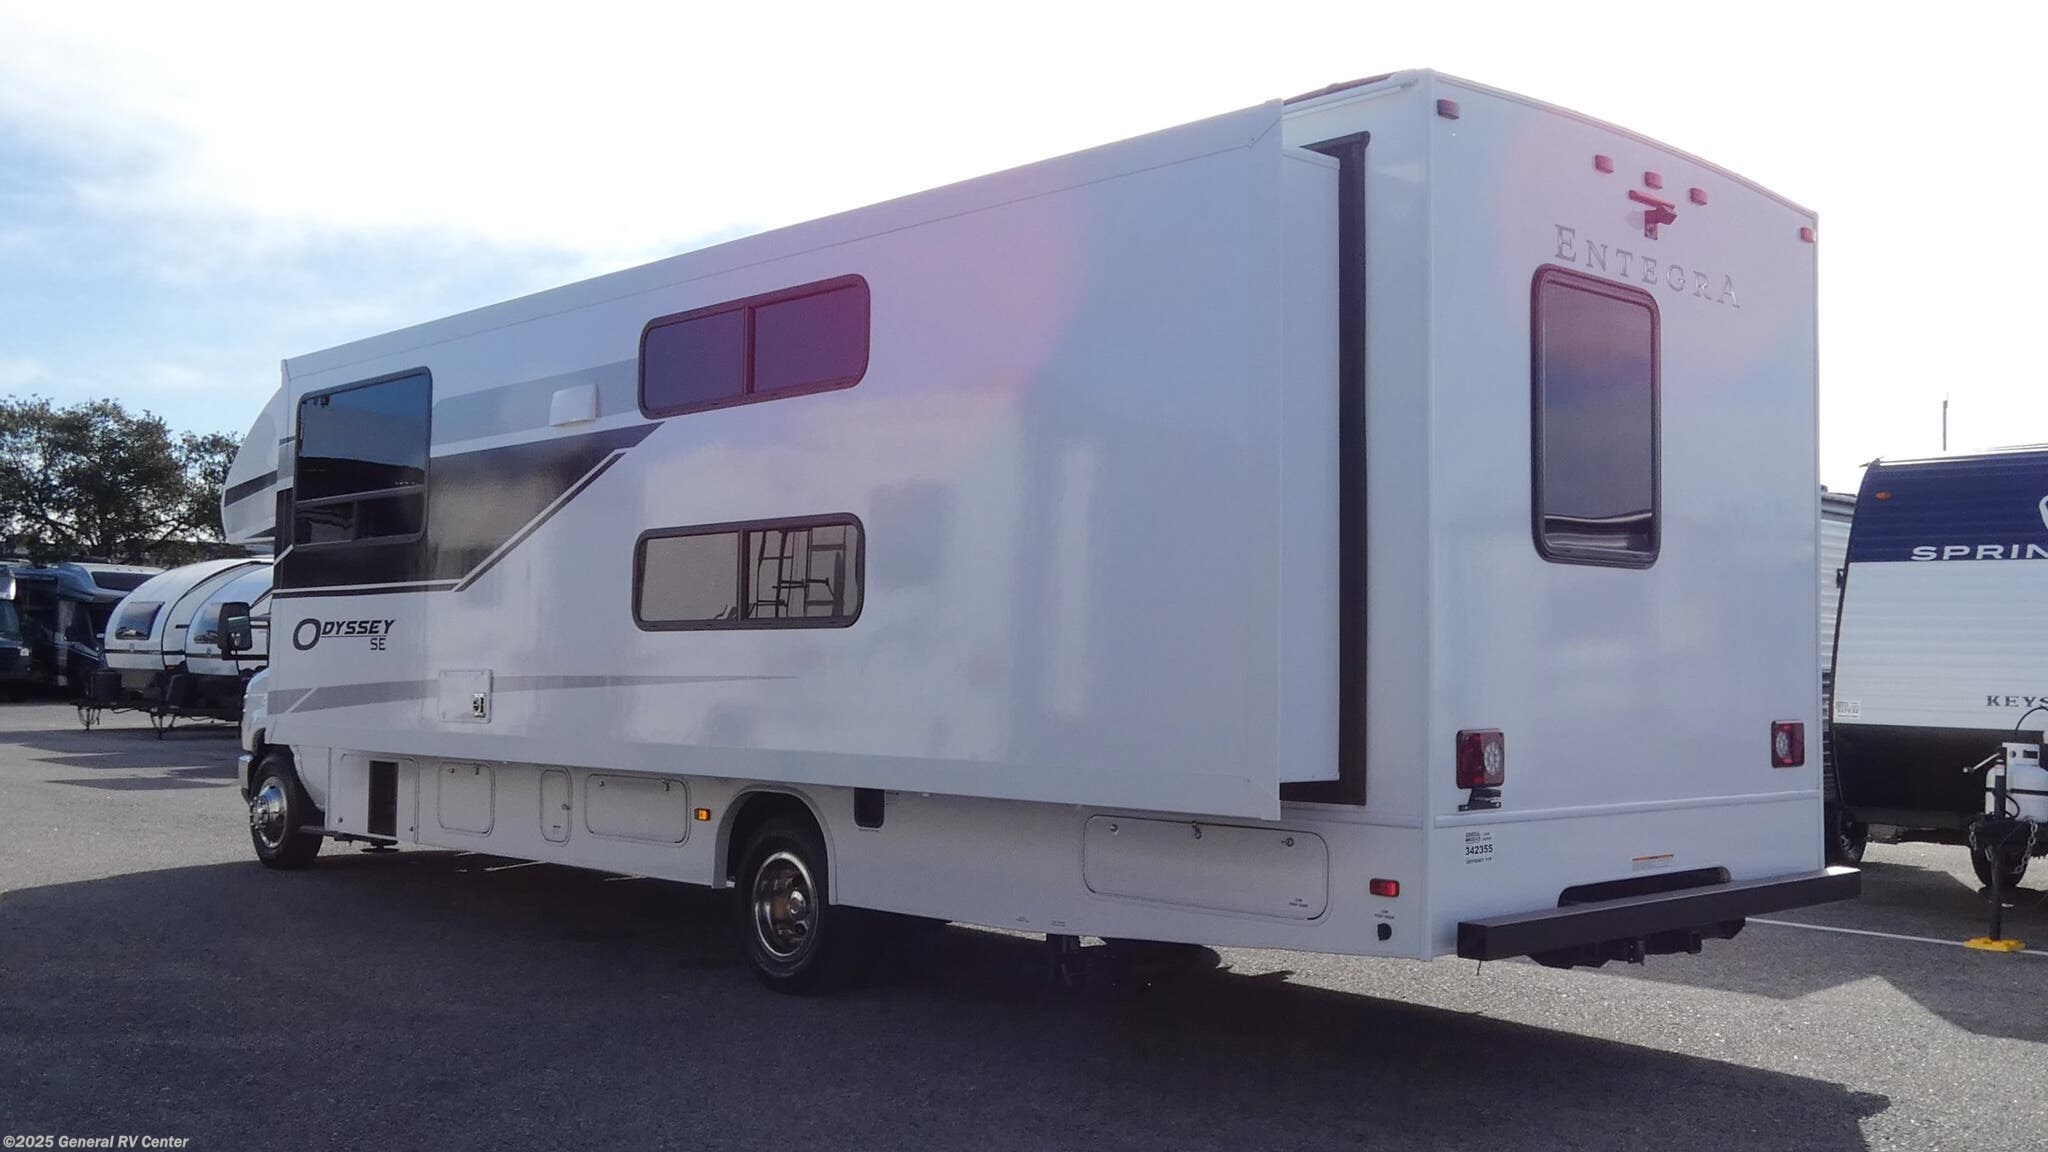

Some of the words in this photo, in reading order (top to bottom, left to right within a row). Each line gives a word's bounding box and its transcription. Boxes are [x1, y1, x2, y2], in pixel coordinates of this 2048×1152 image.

[1554, 223, 1740, 309] ENTEGRA
[1910, 543, 2048, 561] SPRIN
[292, 617, 396, 651] ODYSSEY
[369, 637, 386, 651] SE
[1986, 695, 2048, 708] KEYS
[1464, 844, 1493, 856] 342355
